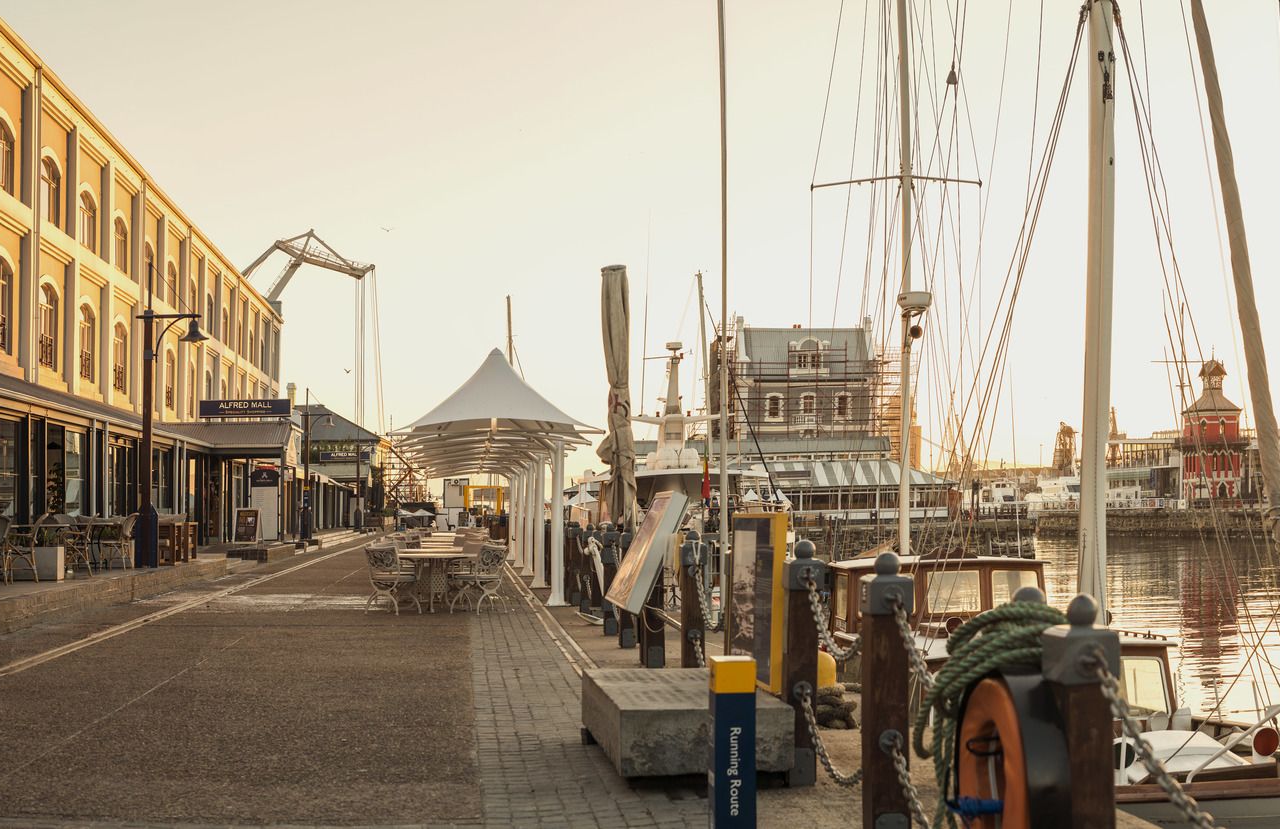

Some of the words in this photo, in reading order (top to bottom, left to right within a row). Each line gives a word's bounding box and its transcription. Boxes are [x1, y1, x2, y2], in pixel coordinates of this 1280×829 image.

[219, 401, 249, 409] ALFRED
[726, 727, 742, 776] Running
[730, 779, 742, 816] Route
